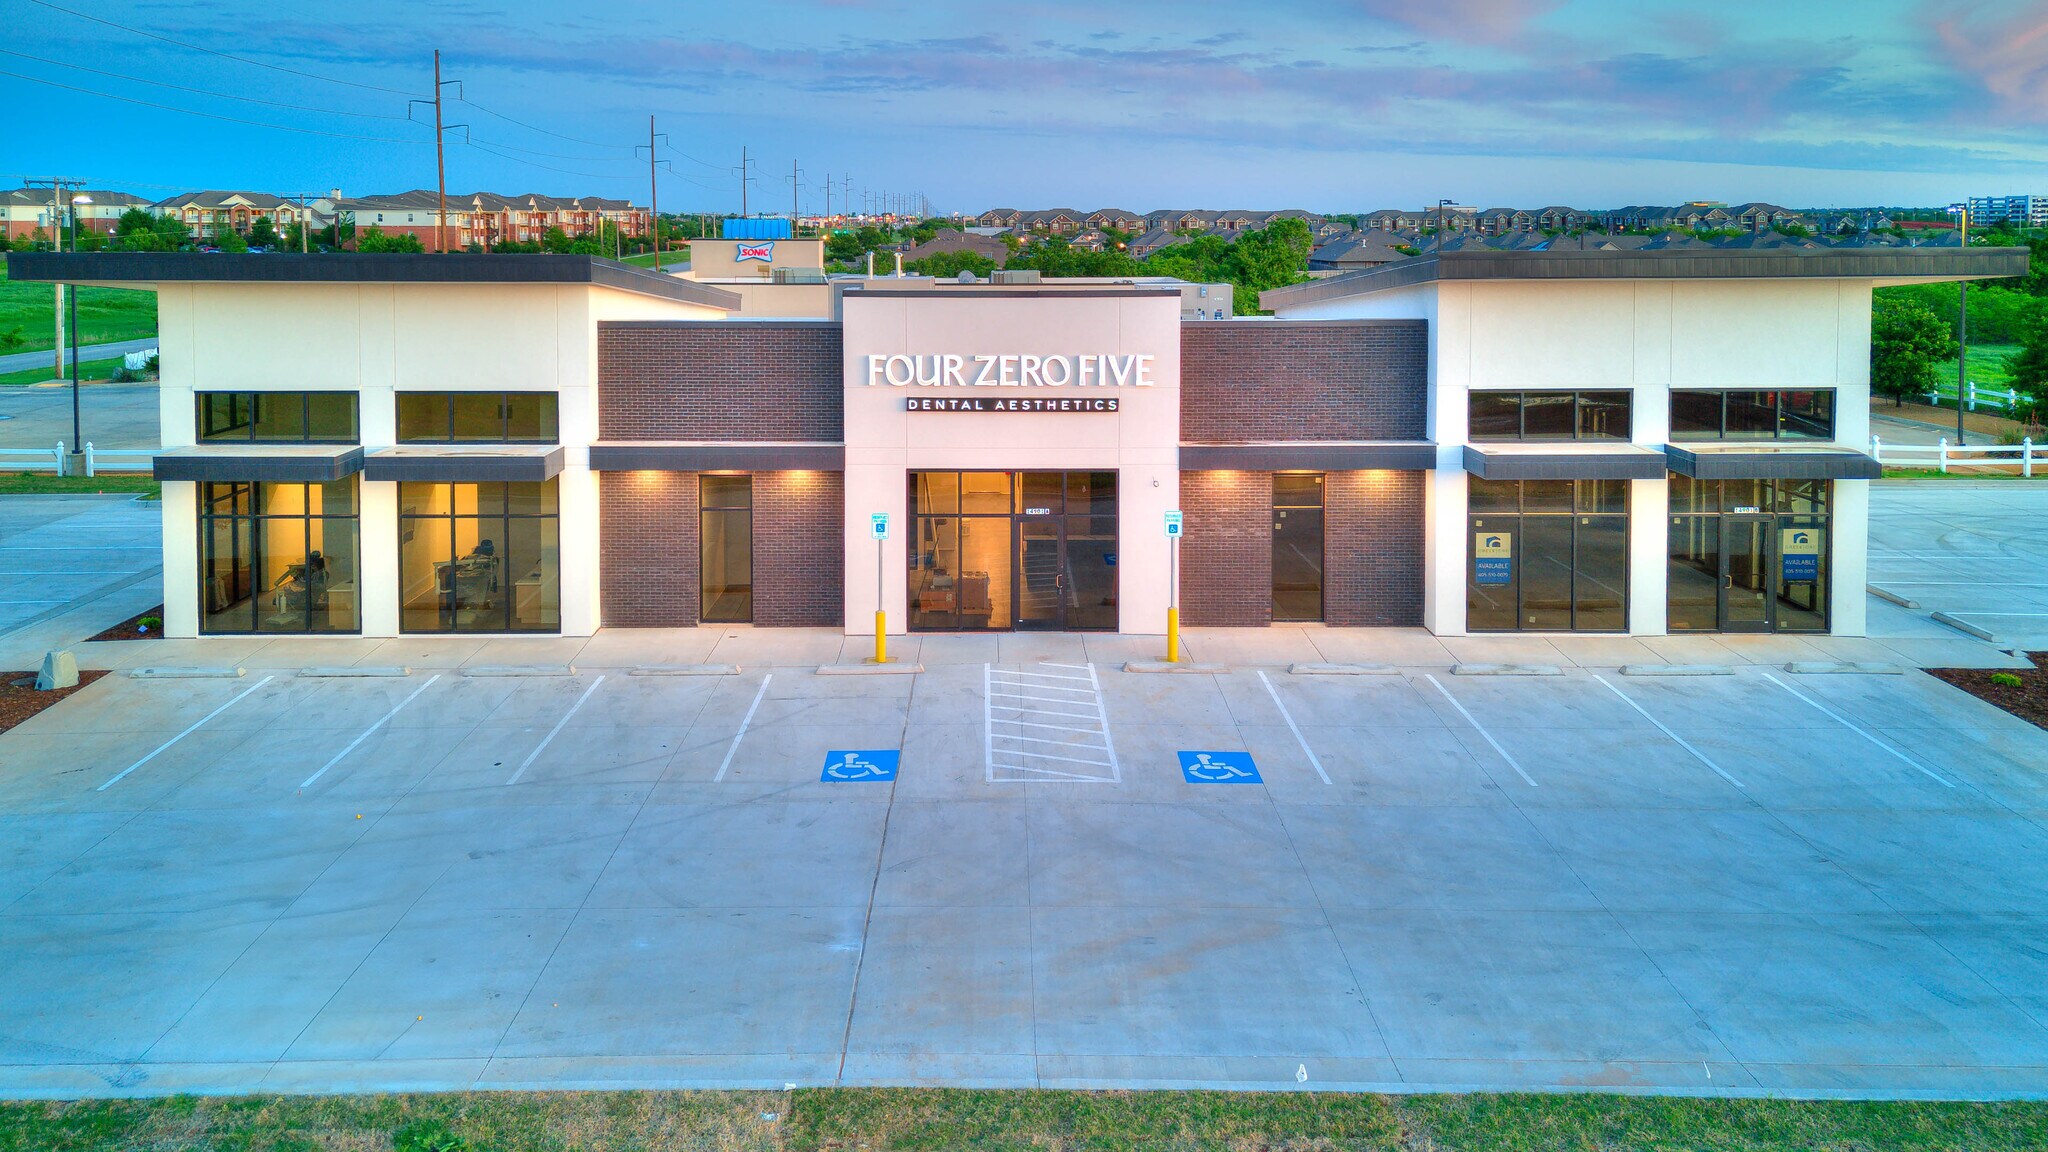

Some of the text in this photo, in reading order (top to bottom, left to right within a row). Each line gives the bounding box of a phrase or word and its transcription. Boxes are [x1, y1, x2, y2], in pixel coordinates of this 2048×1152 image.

[741, 248, 769, 257] SONIC
[868, 354, 1155, 387] FOUR ZERO FIVE
[908, 399, 1118, 411] DENTAL AESTHETICS
